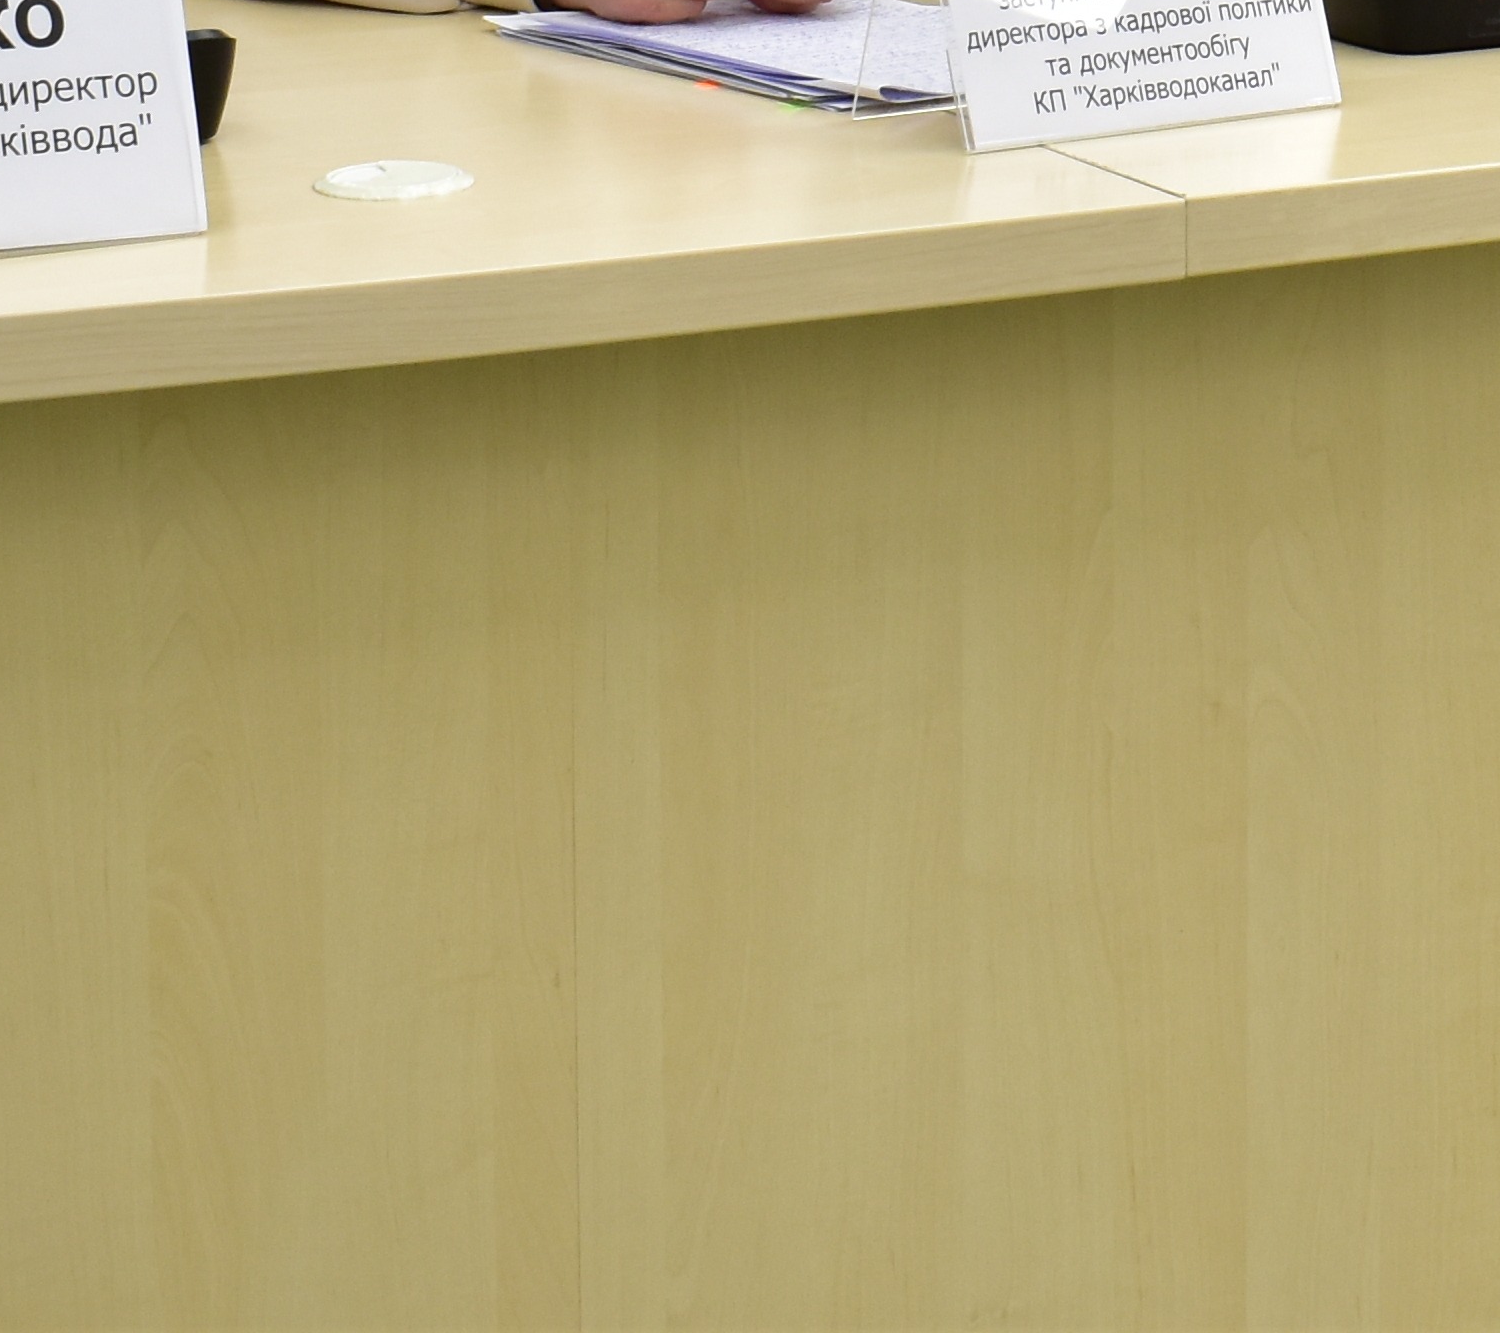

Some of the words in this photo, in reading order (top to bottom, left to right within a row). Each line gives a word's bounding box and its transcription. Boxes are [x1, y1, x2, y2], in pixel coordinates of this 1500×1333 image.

[966, 18, 1088, 55] директора
[1113, 1, 1213, 37] кадрової
[1045, 55, 1072, 77] та
[1079, 33, 1251, 78] документообігу
[1032, 87, 1068, 115] КП
[1073, 61, 1282, 110] "Харківводоканал"
